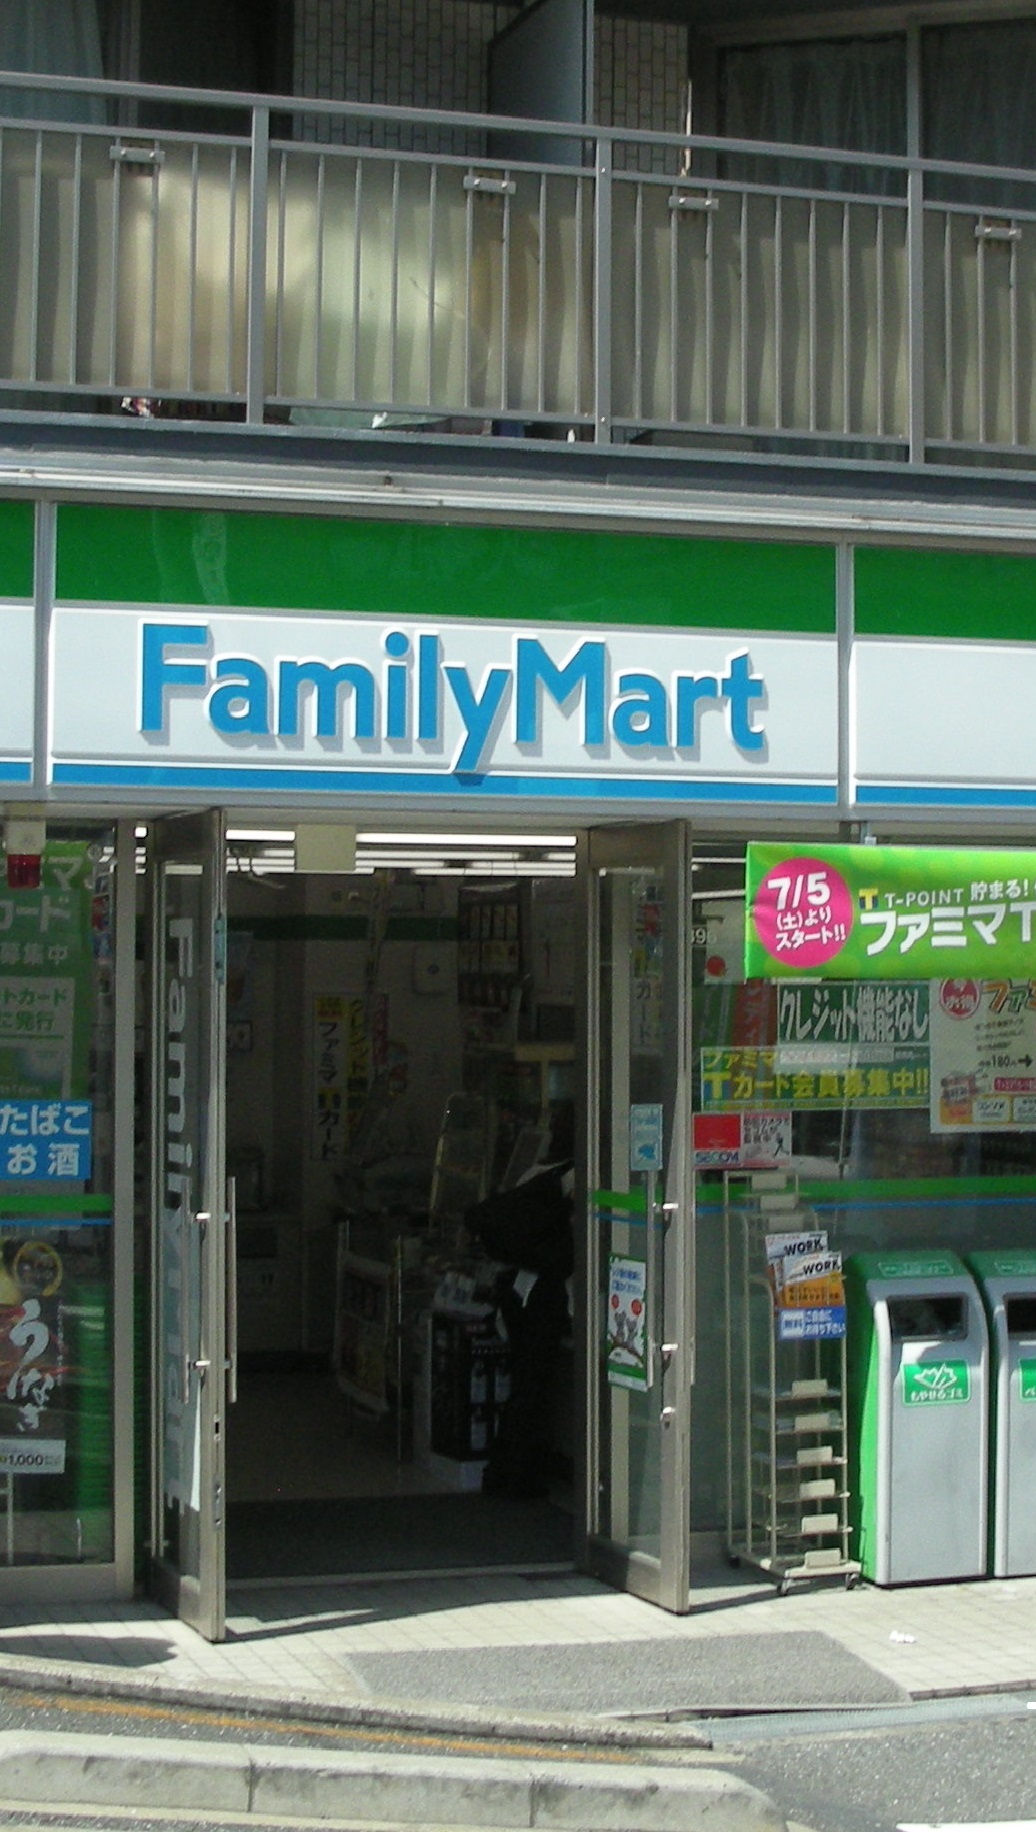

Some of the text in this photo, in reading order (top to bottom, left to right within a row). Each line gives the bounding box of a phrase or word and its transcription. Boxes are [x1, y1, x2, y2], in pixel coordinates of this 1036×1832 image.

[138, 620, 764, 774] FamilyMart
[767, 872, 831, 910] 7/5
[884, 888, 964, 909] T-POINT
[776, 906, 831, 931] (土)より
[775, 924, 847, 951] スタート!!
[0, 1102, 90, 1137] たばこ
[7, 1142, 80, 1177] お酒
